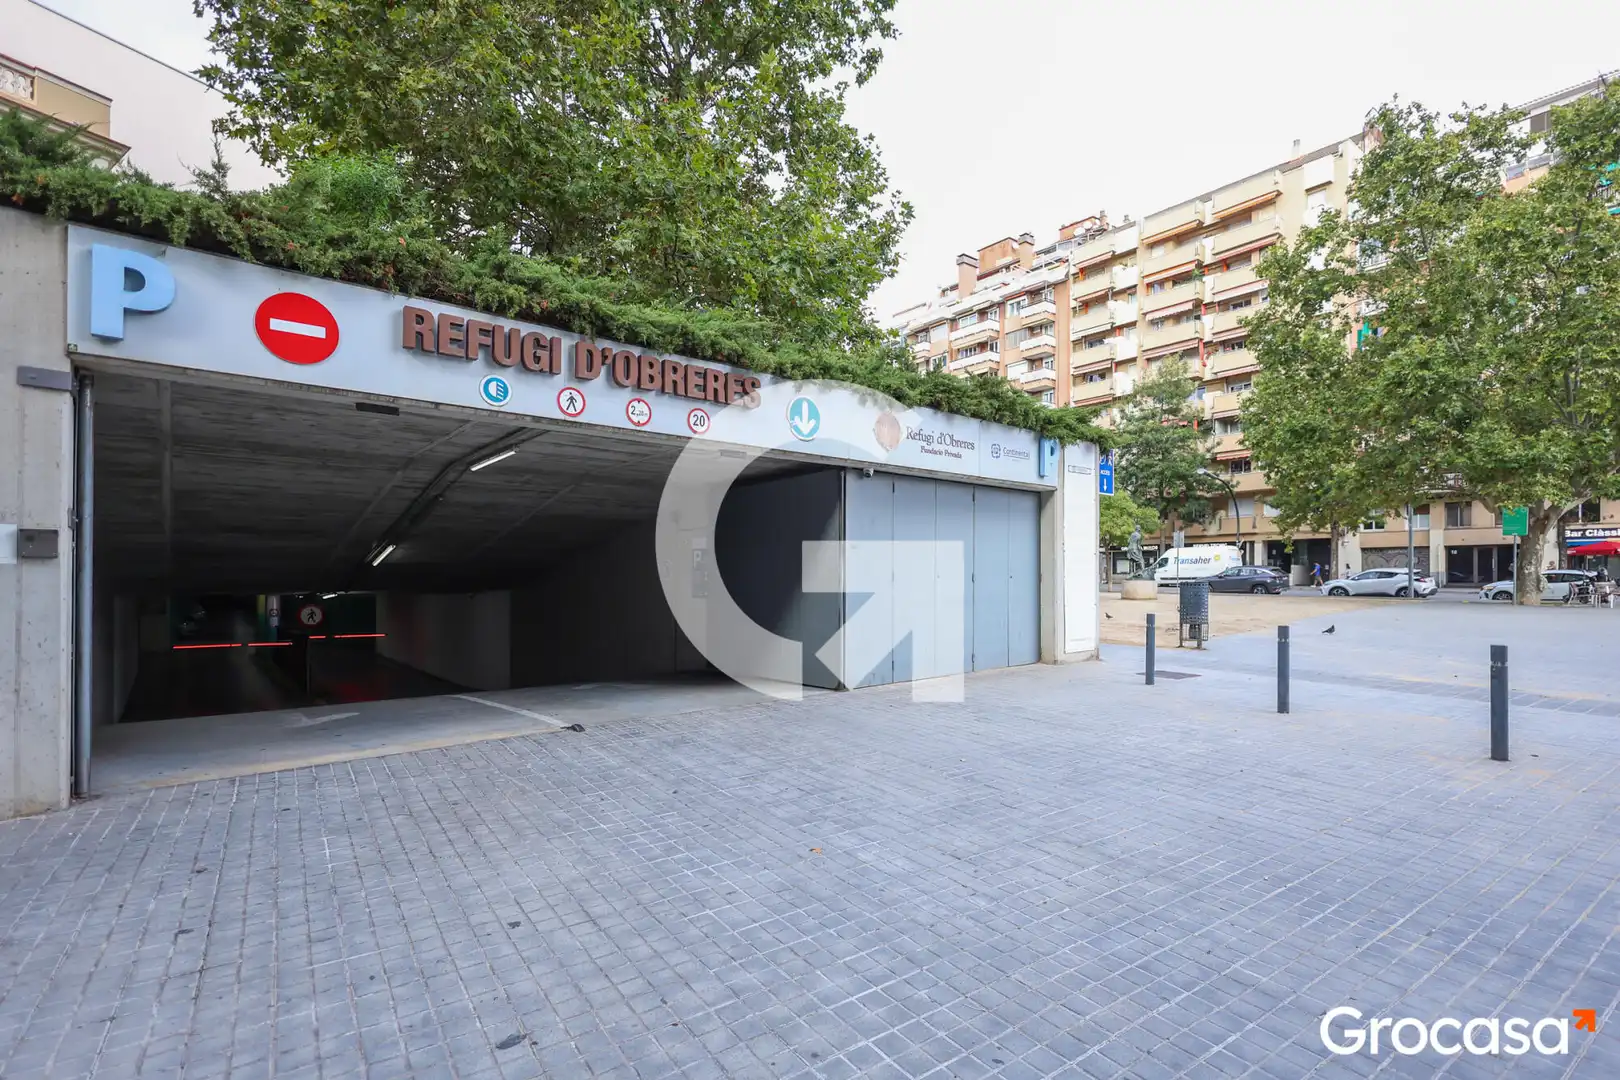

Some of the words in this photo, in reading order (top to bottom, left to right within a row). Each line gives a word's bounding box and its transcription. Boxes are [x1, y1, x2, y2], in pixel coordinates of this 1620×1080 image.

[89, 243, 176, 341] P
[402, 305, 562, 375] REFUGI
[575, 338, 762, 409] D'OBRERES
[692, 414, 705, 427] 20
[906, 426, 934, 446] Refugi
[936, 432, 975, 451] d'Obreres
[1173, 556, 1211, 565] Transaher
